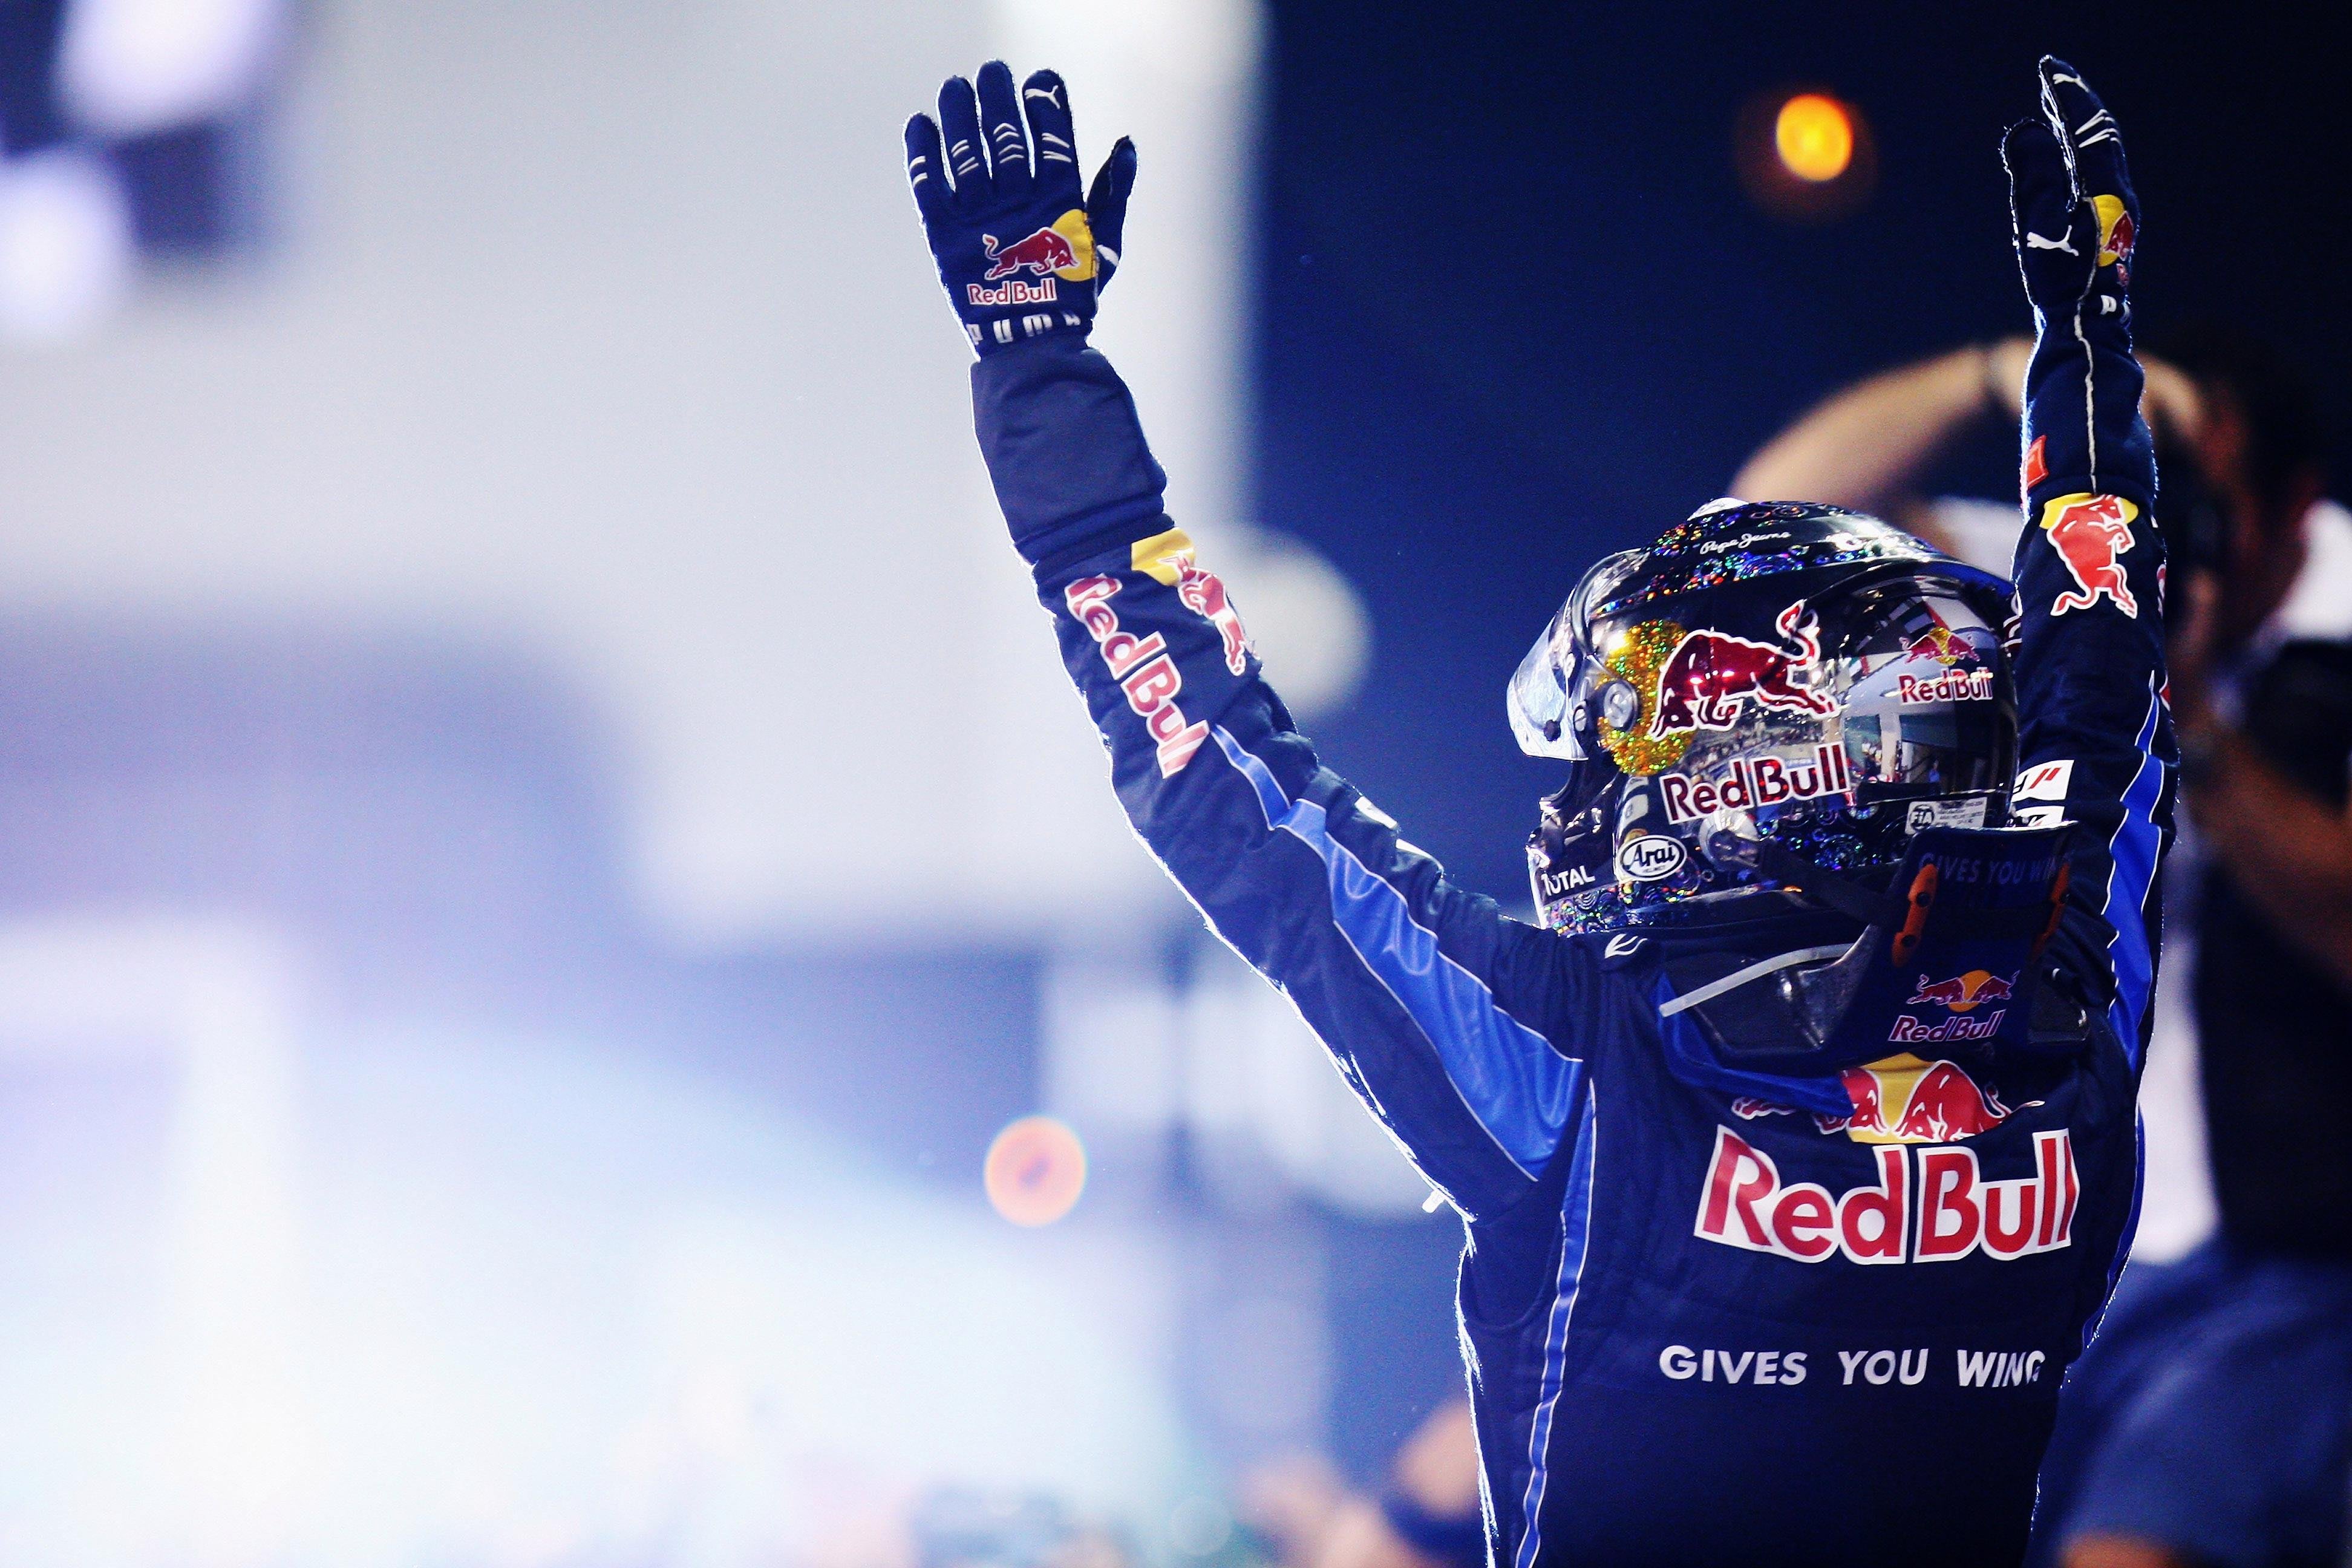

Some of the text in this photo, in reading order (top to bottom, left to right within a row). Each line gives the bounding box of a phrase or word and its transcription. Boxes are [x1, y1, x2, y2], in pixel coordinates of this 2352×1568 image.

[967, 278, 1057, 305] Red Bull
[1064, 573, 1210, 779] Red Bull
[1898, 667, 1994, 704] Red Bull
[1659, 743, 1852, 825] Red Bull
[1627, 841, 1676, 867] Arai
[1988, 860, 2026, 885] YOU
[1888, 1009, 2006, 1042] Red Bull
[1694, 1123, 2080, 1265] Red Bull
[1659, 1345, 1808, 1386] GIVES
[1837, 1348, 1929, 1386] YOU
